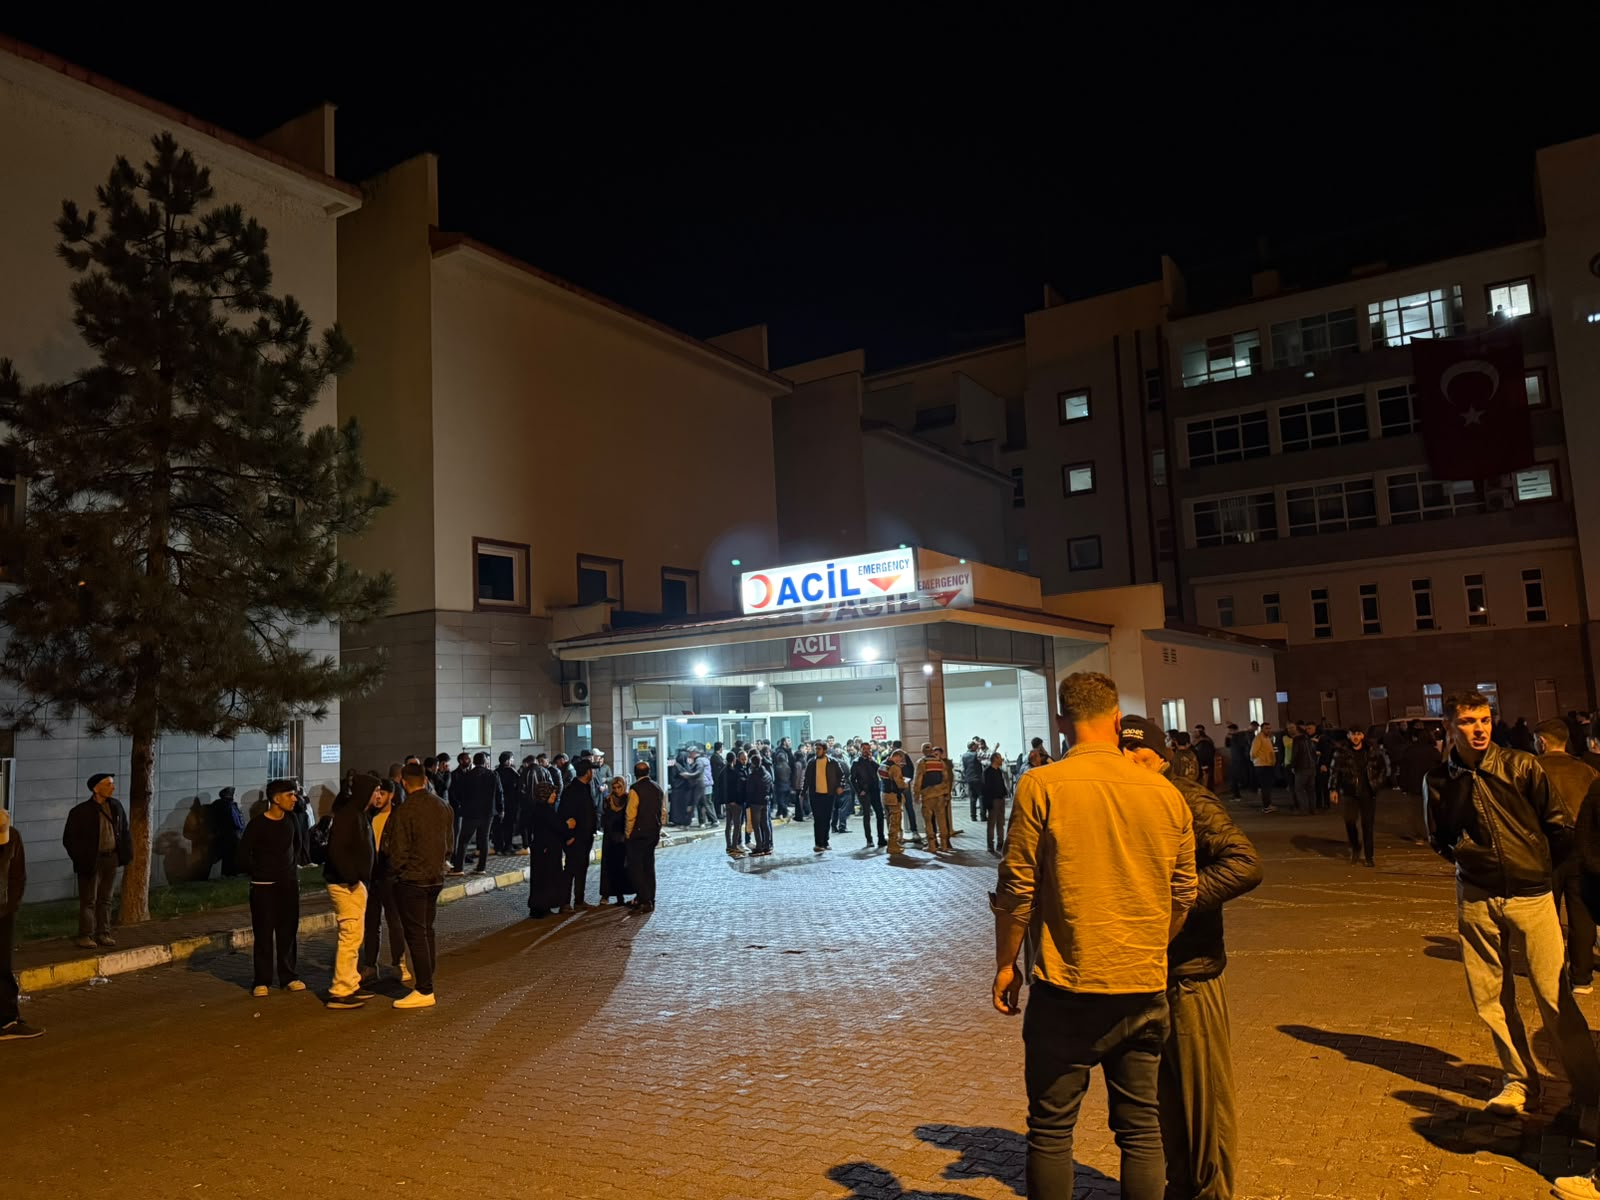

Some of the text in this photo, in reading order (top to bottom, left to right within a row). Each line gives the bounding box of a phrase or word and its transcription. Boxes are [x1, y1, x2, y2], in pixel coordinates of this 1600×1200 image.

[858, 559, 910, 576] EMERGENCY
[777, 563, 861, 606] ACİL
[917, 573, 969, 591] EMERGENCY
